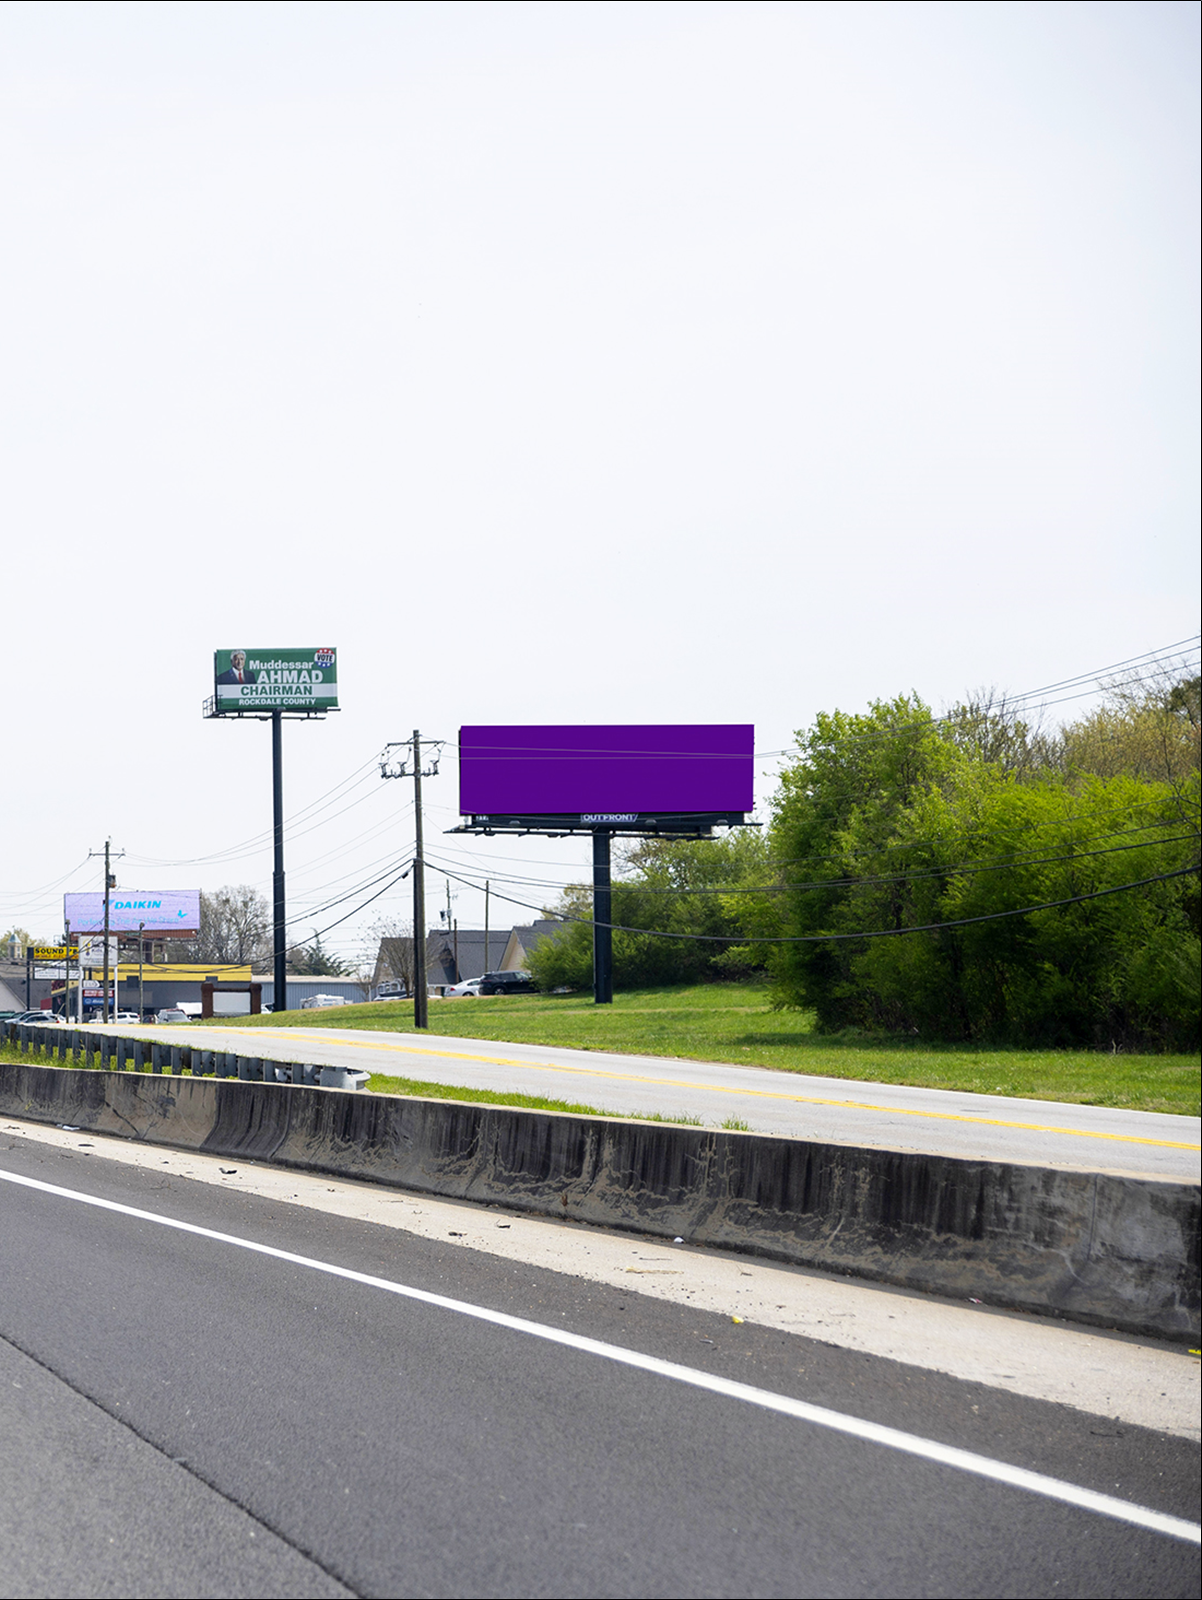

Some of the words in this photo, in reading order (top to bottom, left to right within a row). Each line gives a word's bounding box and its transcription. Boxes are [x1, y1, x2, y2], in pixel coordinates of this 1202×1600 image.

[317, 653, 333, 662] VOTE
[249, 660, 314, 670] Muddessar
[257, 670, 323, 684] AHMAD
[241, 685, 313, 696] CHAIRMAN
[238, 698, 281, 706] ROCKDALE
[282, 697, 317, 705] COUNTY
[583, 814, 634, 822] OUTFRONT
[114, 900, 162, 910] DAIKIN
[35, 947, 65, 955] SOUND
